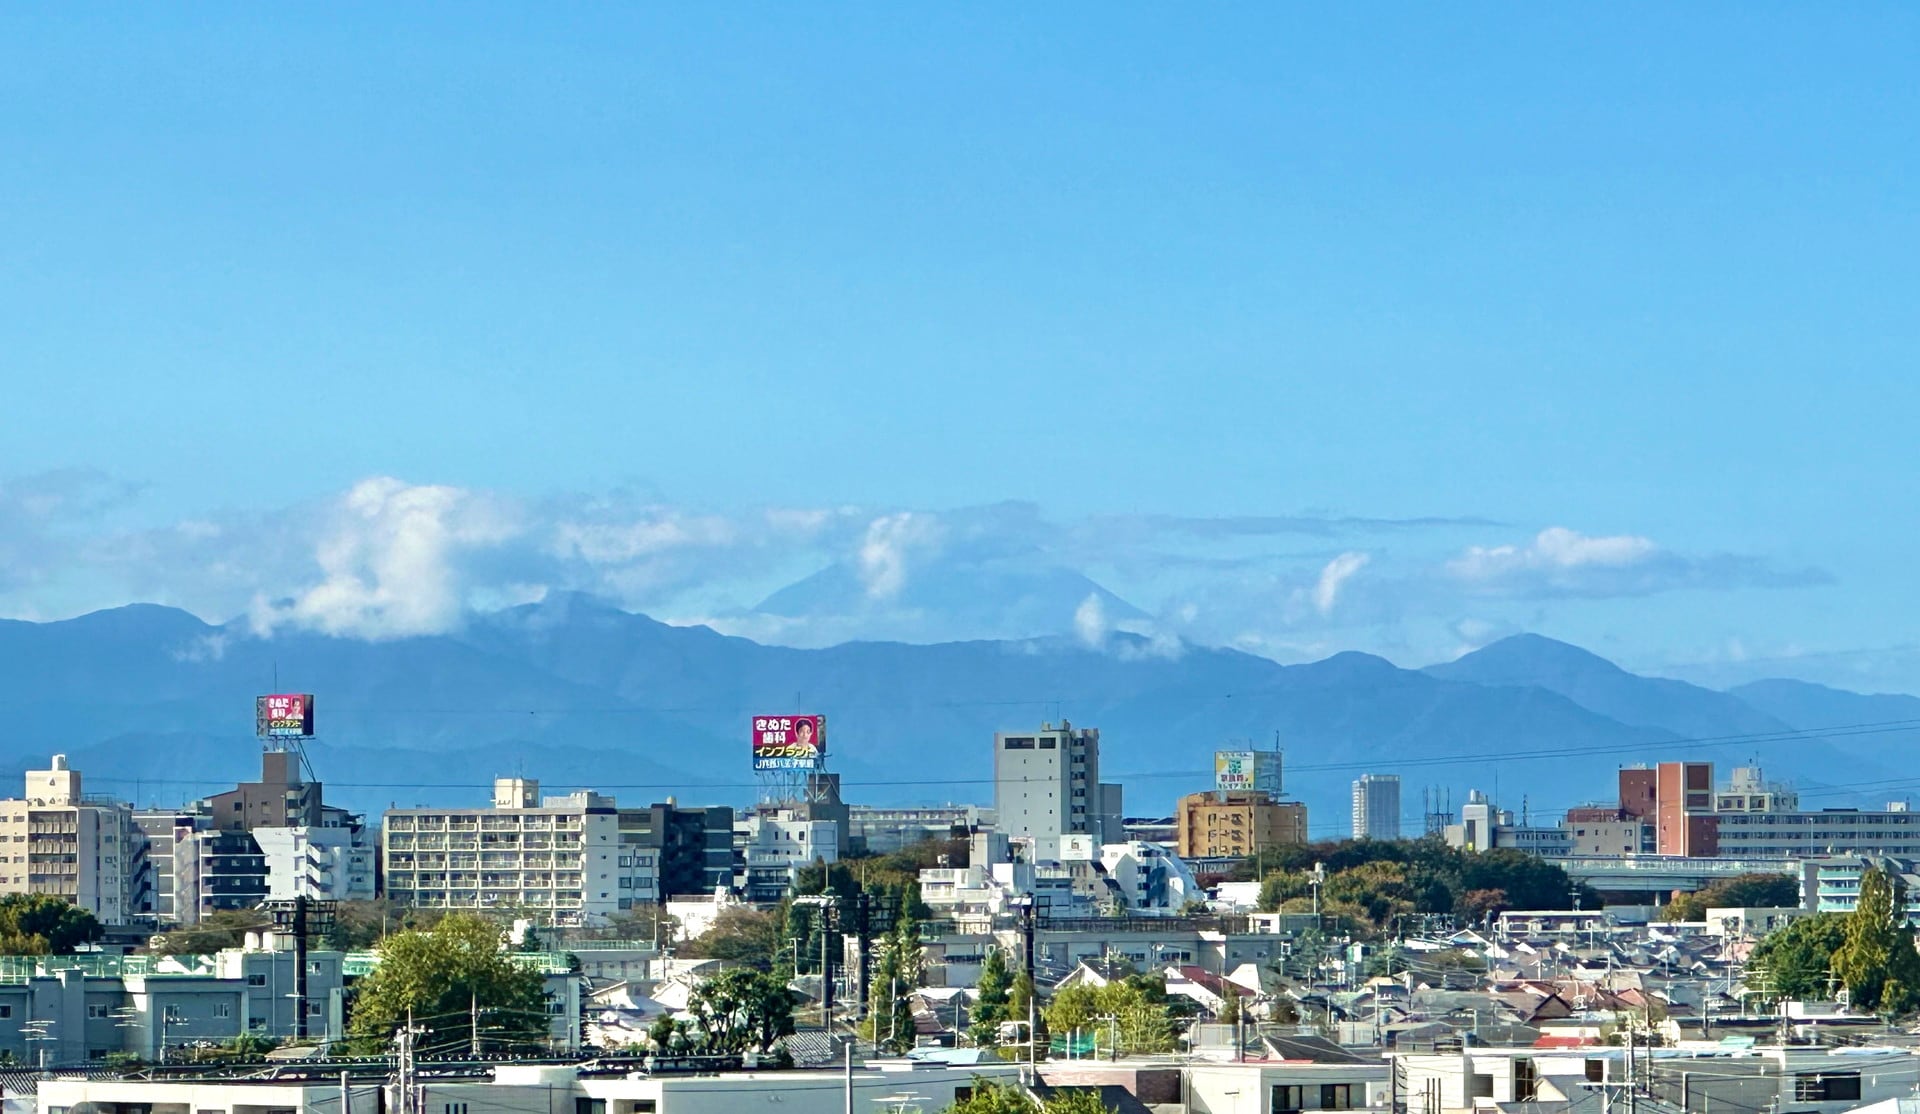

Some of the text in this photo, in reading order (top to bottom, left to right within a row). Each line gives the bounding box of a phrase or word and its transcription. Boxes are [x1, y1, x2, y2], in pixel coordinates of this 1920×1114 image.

[755, 718, 791, 731] きぬた
[762, 731, 786, 744] 歯科
[755, 746, 816, 758] インプラント
